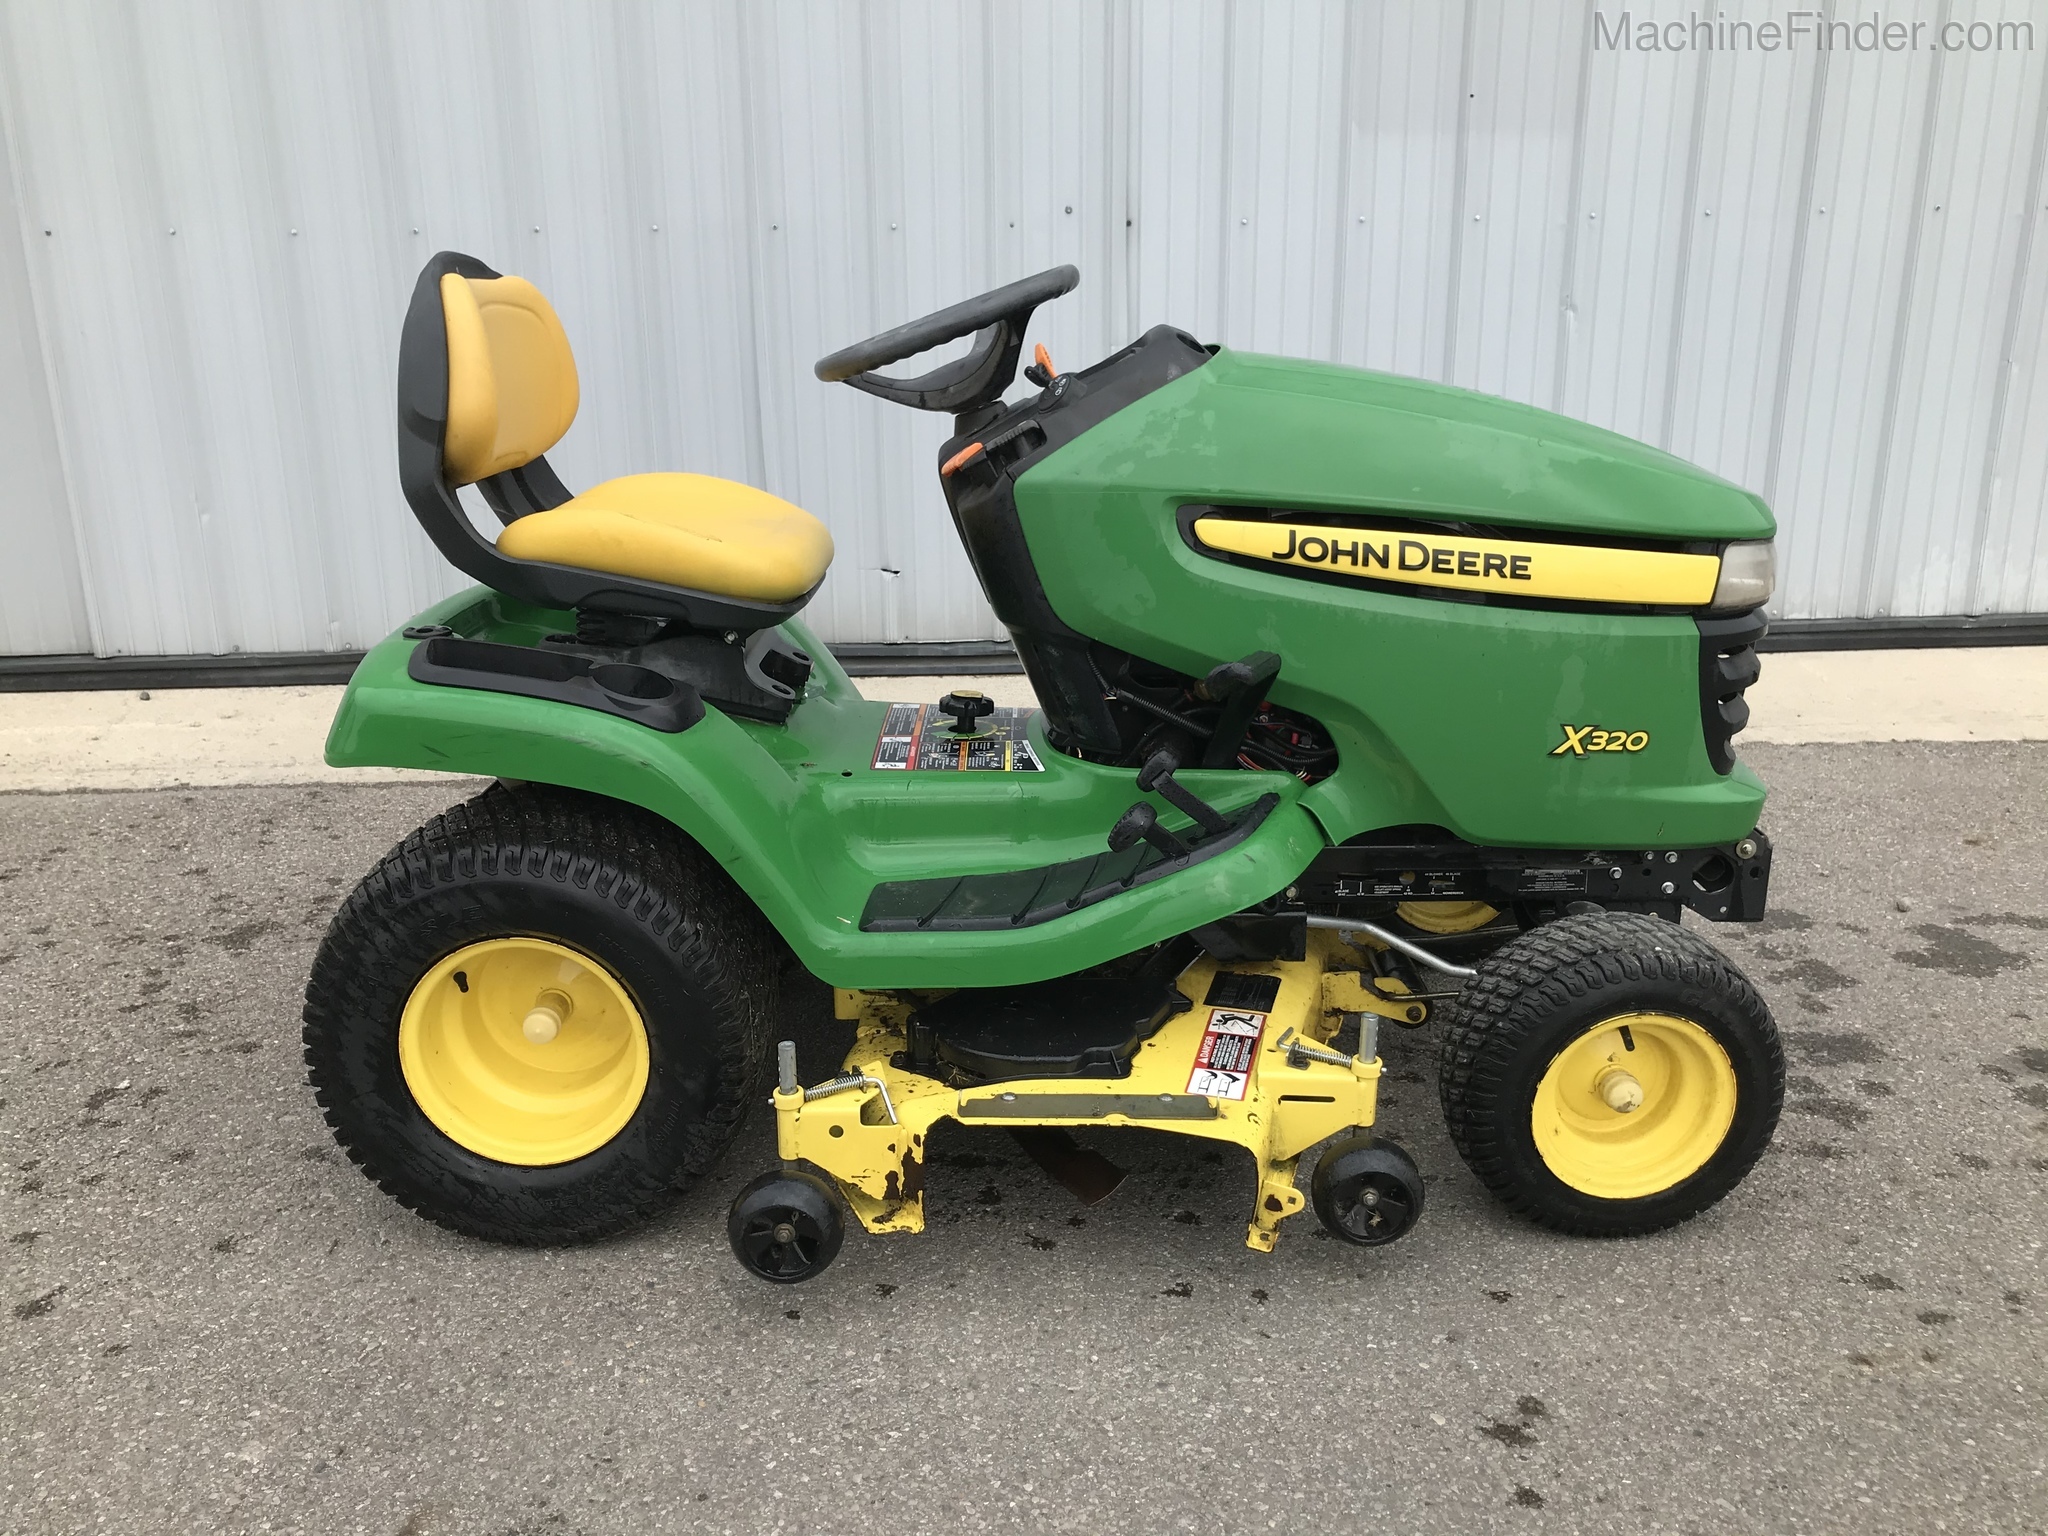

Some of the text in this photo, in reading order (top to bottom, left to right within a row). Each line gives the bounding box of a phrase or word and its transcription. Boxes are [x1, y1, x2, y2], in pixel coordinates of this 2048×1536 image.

[1272, 529, 1532, 581] JOHN DEERE
[1547, 723, 1650, 756] X320
[1199, 1035, 1214, 1058] DANGER
